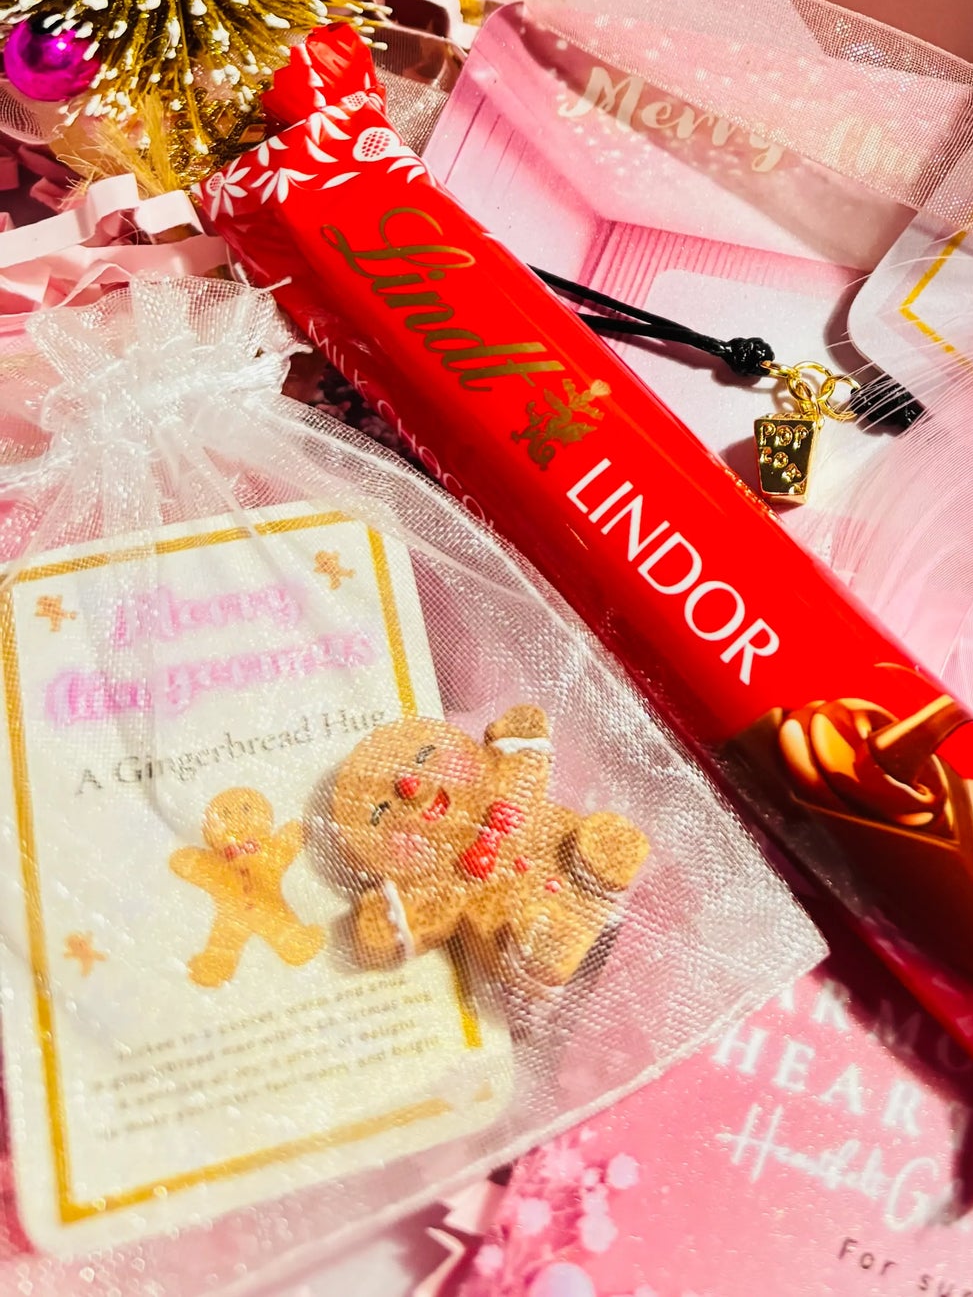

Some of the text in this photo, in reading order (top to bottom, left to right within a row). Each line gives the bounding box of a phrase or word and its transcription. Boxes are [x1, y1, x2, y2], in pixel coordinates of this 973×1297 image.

[557, 66, 786, 173] Merry
[320, 205, 565, 394] Lindt
[566, 458, 780, 685] LINDOR
[114, 716, 313, 785] Gingerbread
[836, 1236, 898, 1276] For
